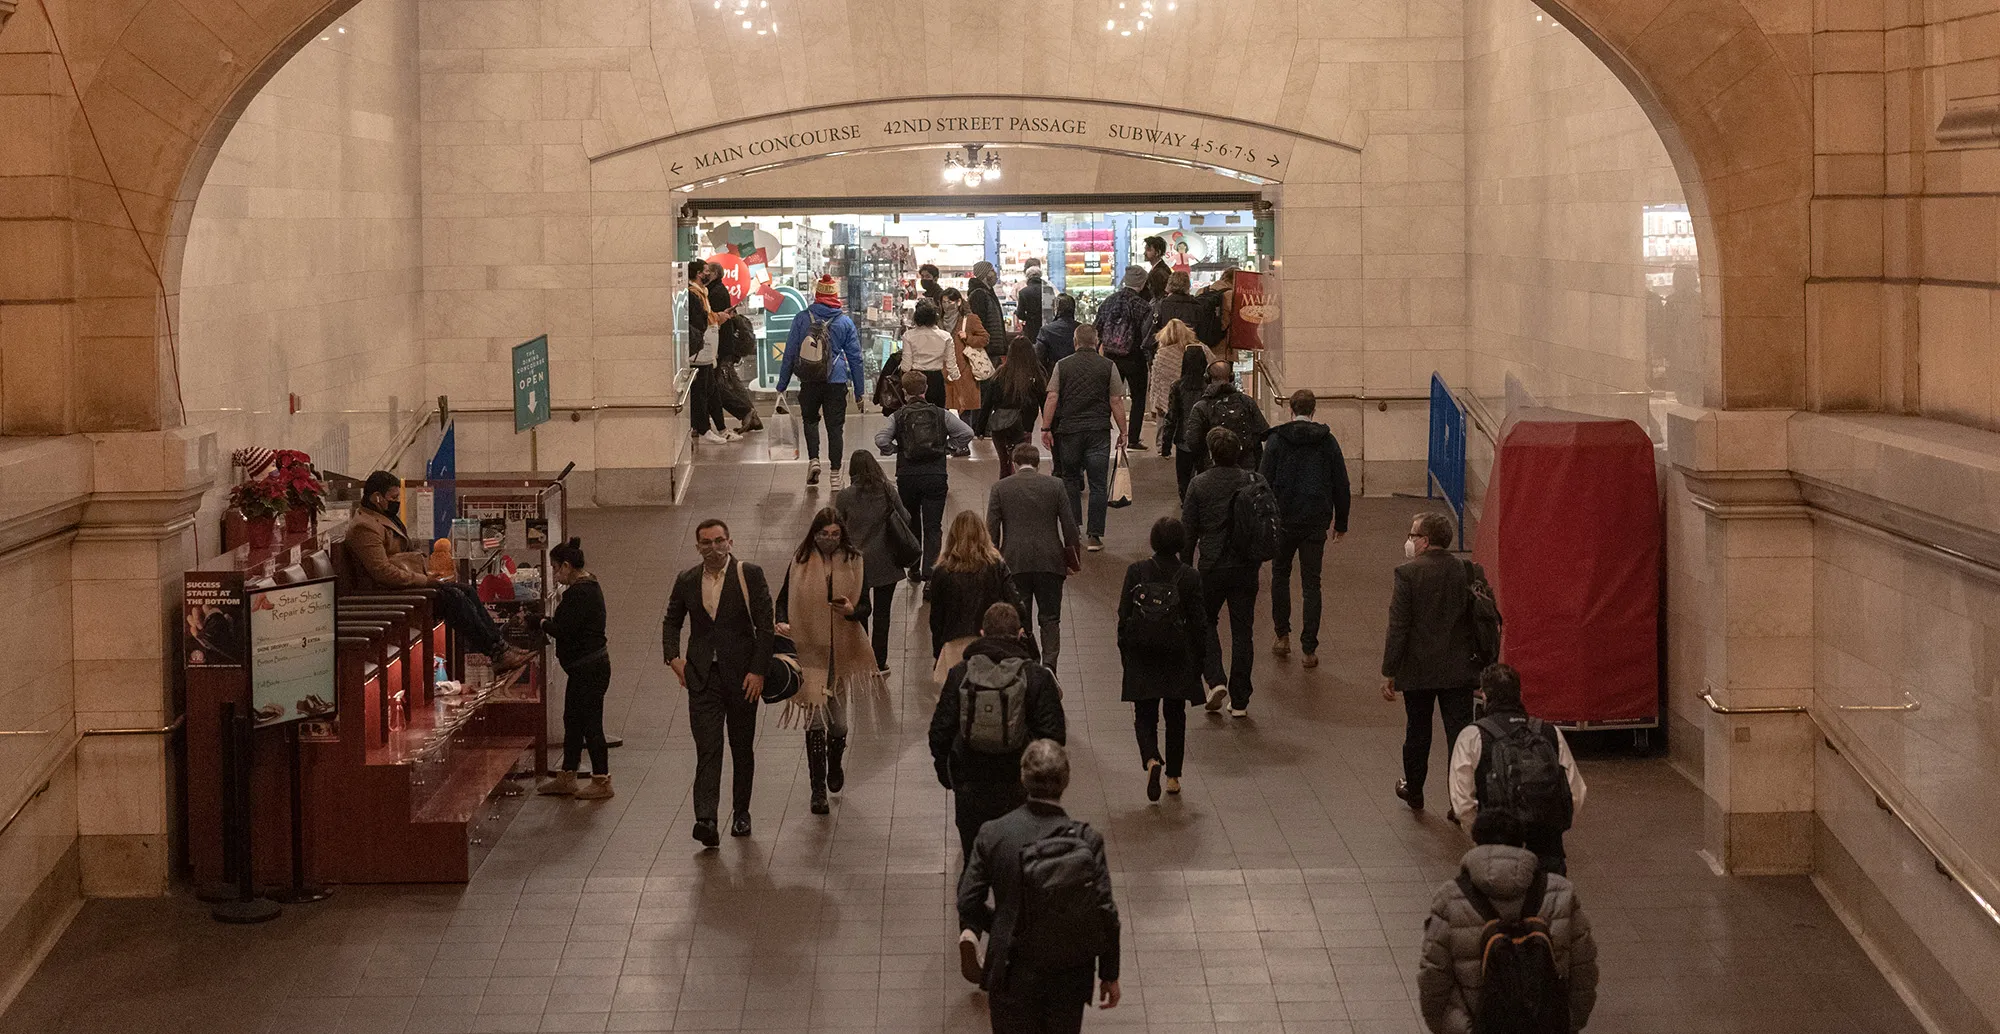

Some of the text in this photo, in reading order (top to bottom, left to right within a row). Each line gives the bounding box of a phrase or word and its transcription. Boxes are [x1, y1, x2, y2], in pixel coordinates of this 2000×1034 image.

[884, 117, 1086, 134] 42ND STREET PASSAGE
[1109, 124, 1187, 147] SUBWAY
[694, 125, 861, 169] MAIN CONCOURSE
[517, 358, 545, 374] CONCOURSE
[519, 372, 543, 389] OPEN
[278, 591, 322, 607] Star Shoe
[272, 608, 298, 620] Repair
[307, 602, 331, 614] Shine
